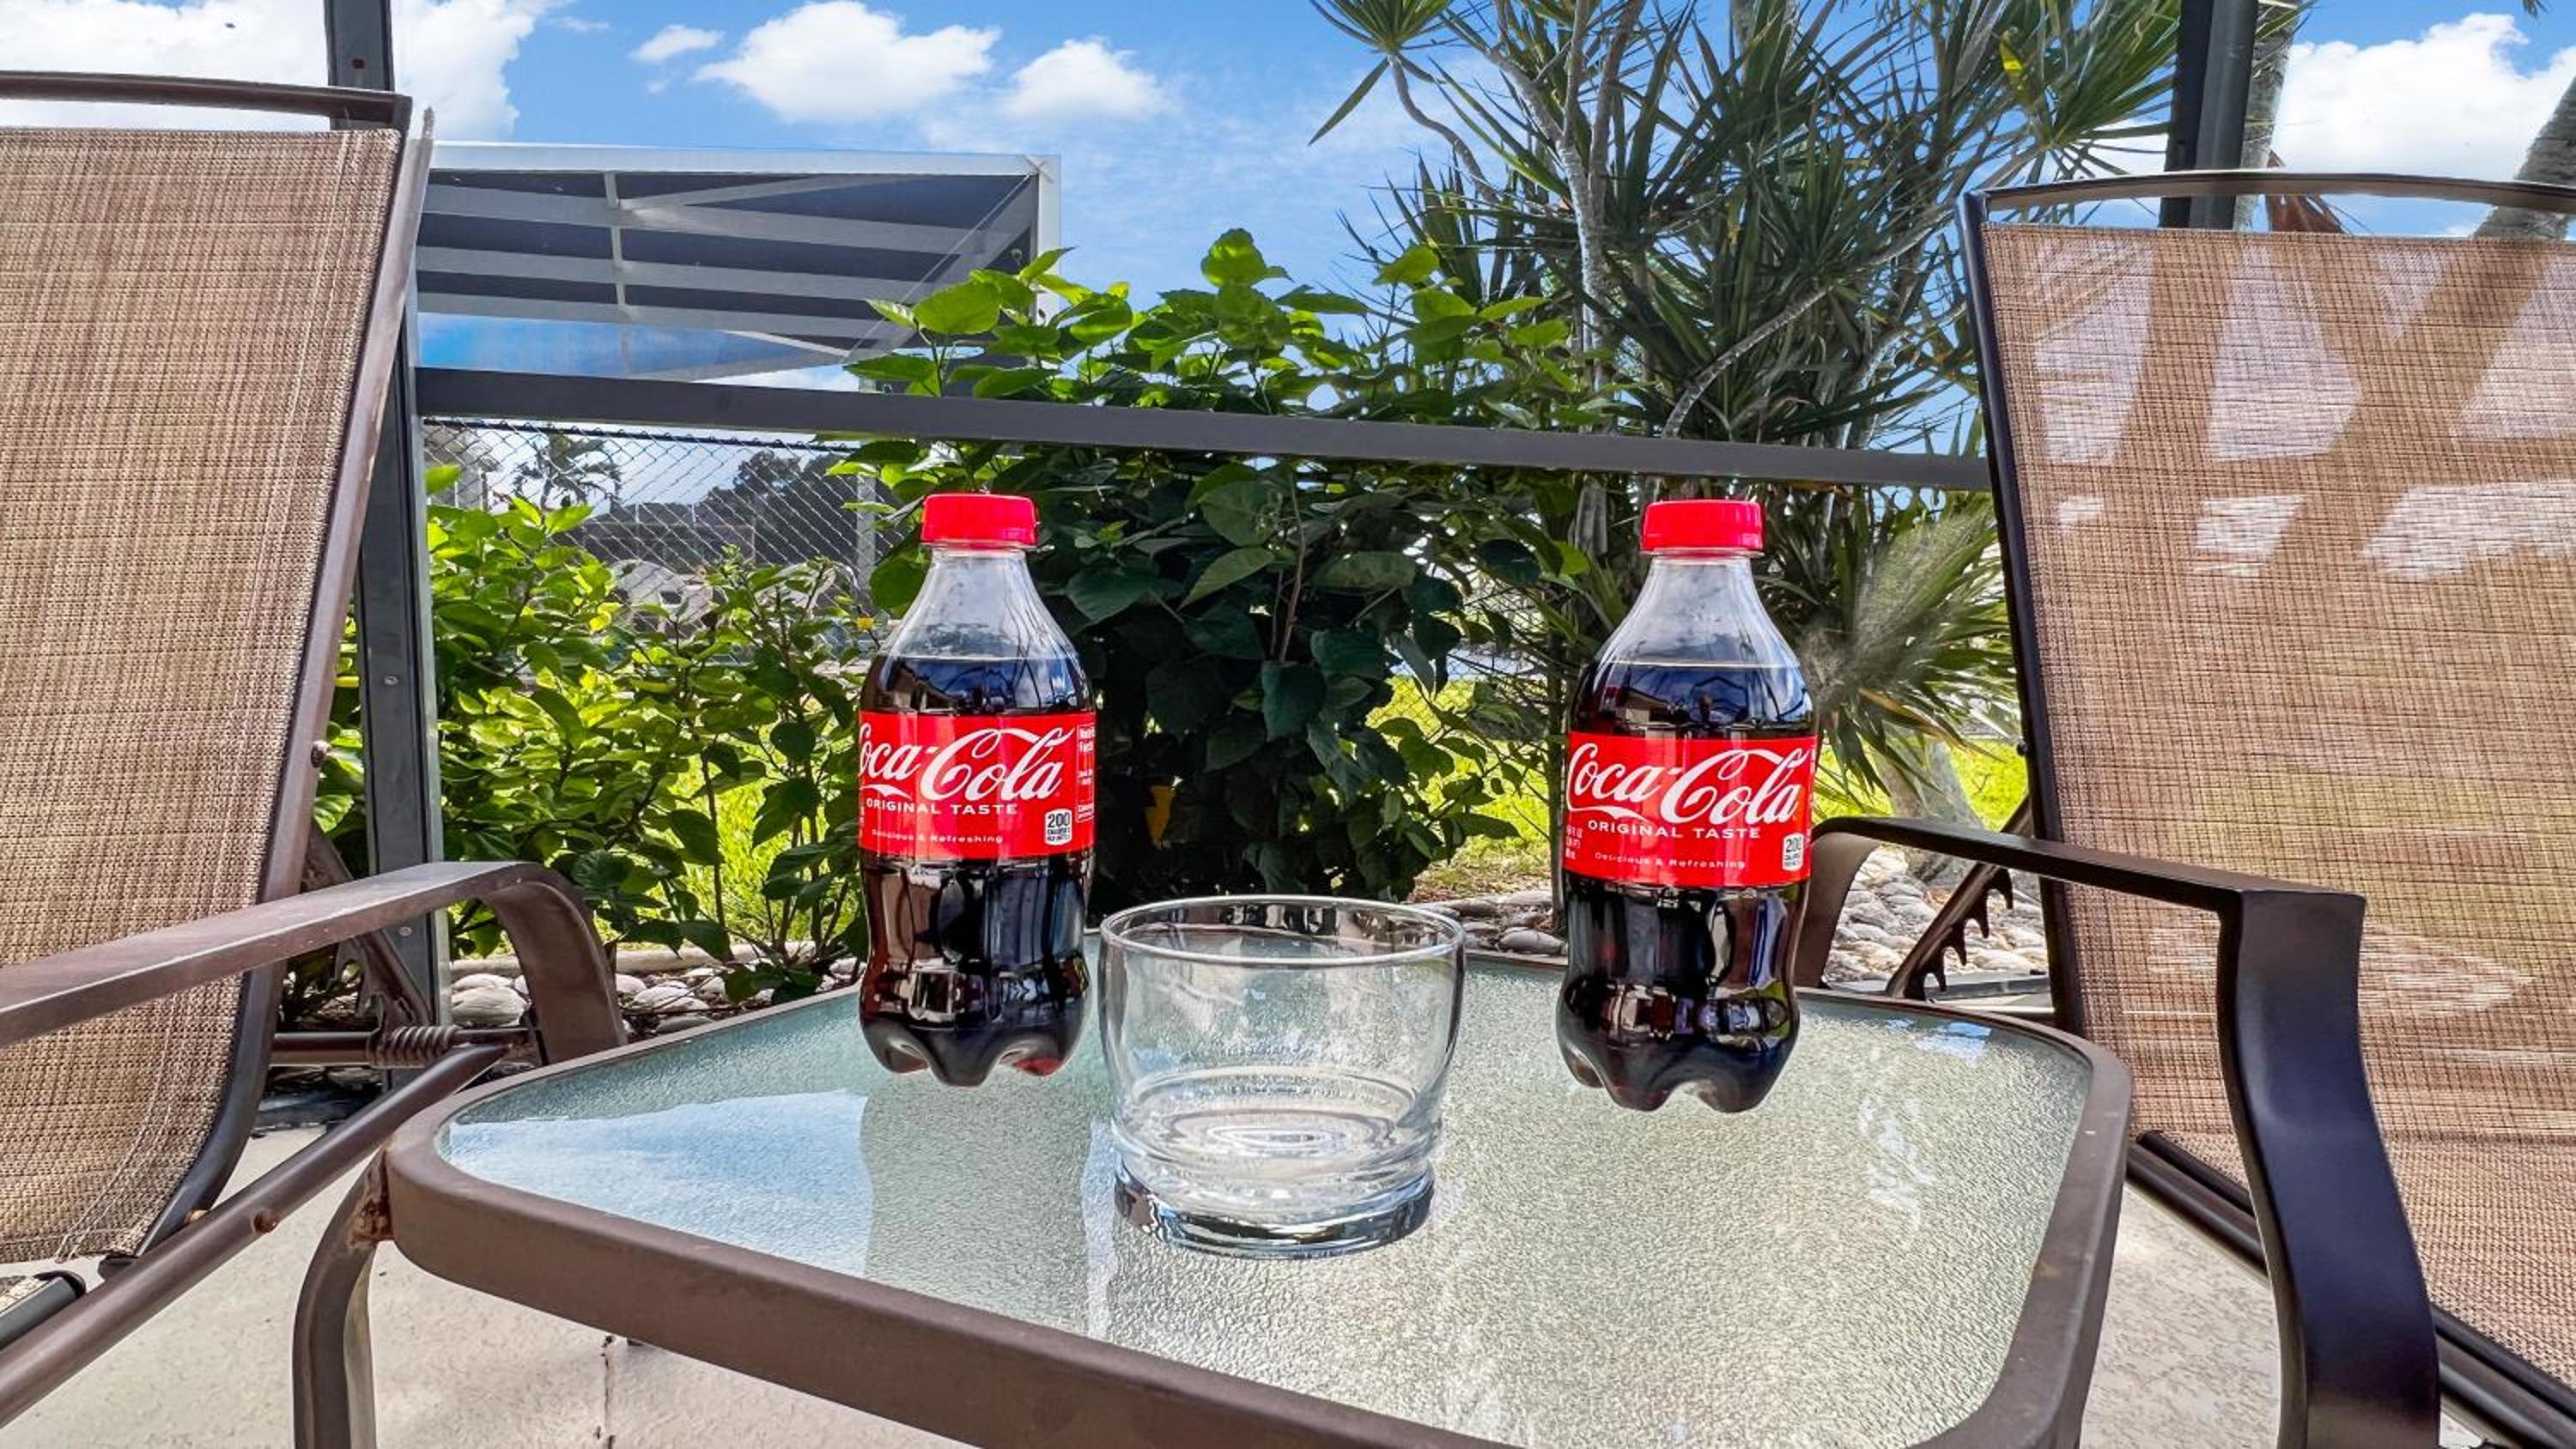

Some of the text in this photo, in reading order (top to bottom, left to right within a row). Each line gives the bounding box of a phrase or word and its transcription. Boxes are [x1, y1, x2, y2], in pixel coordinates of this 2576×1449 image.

[1566, 743, 1810, 824] Coca-Cola
[866, 797, 1018, 815] ORIGINAL TASTE
[1047, 812, 1071, 828] 200
[1588, 820, 1683, 839] ORIGINAL
[1692, 828, 1760, 839] TASTE
[930, 834, 1004, 844] Refreshing
